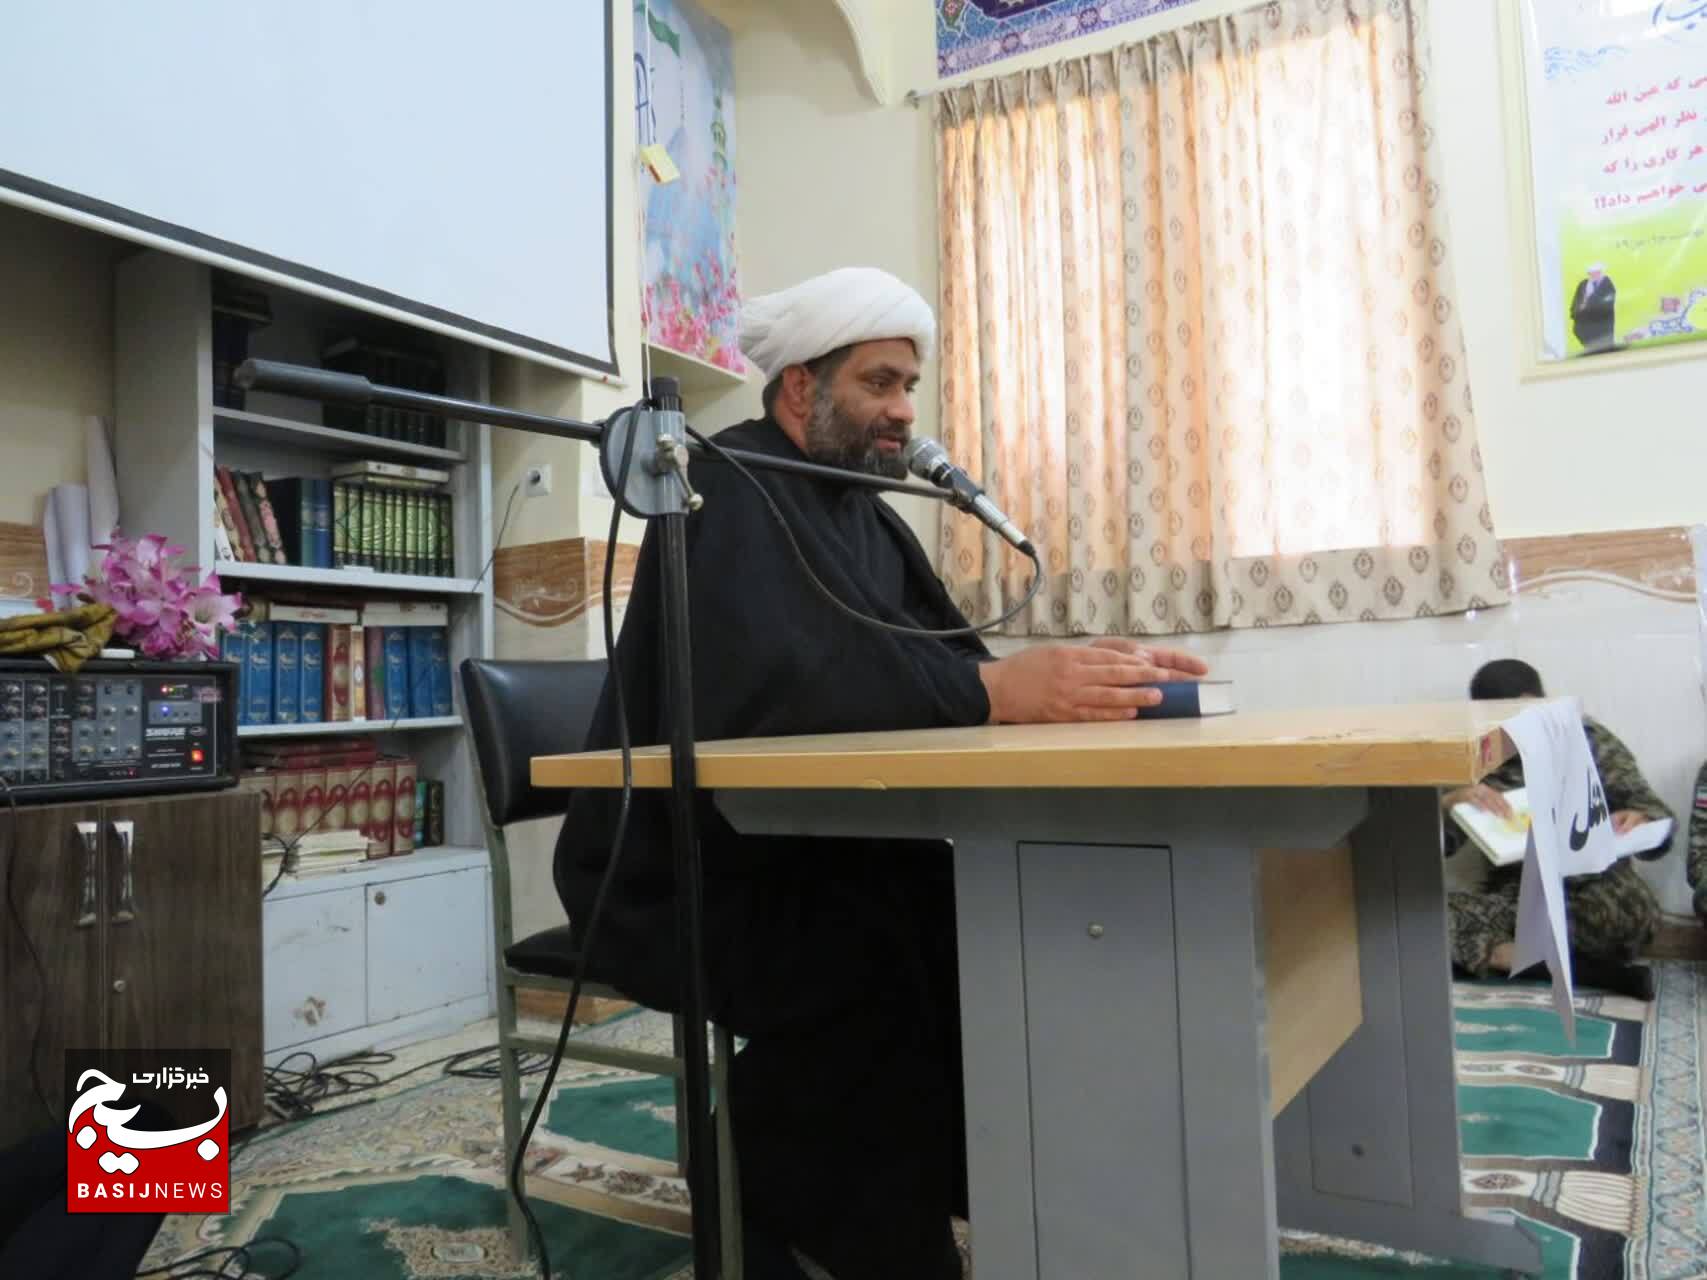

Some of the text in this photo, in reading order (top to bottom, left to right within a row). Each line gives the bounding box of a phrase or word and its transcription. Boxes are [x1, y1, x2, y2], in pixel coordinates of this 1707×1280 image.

[1605, 88, 1628, 104] الله
[1634, 115, 1666, 137] الهی
[1674, 109, 1697, 128] نظر
[1600, 124, 1628, 144] قرار
[1624, 156, 1638, 172] را
[1643, 147, 1677, 169] کاری
